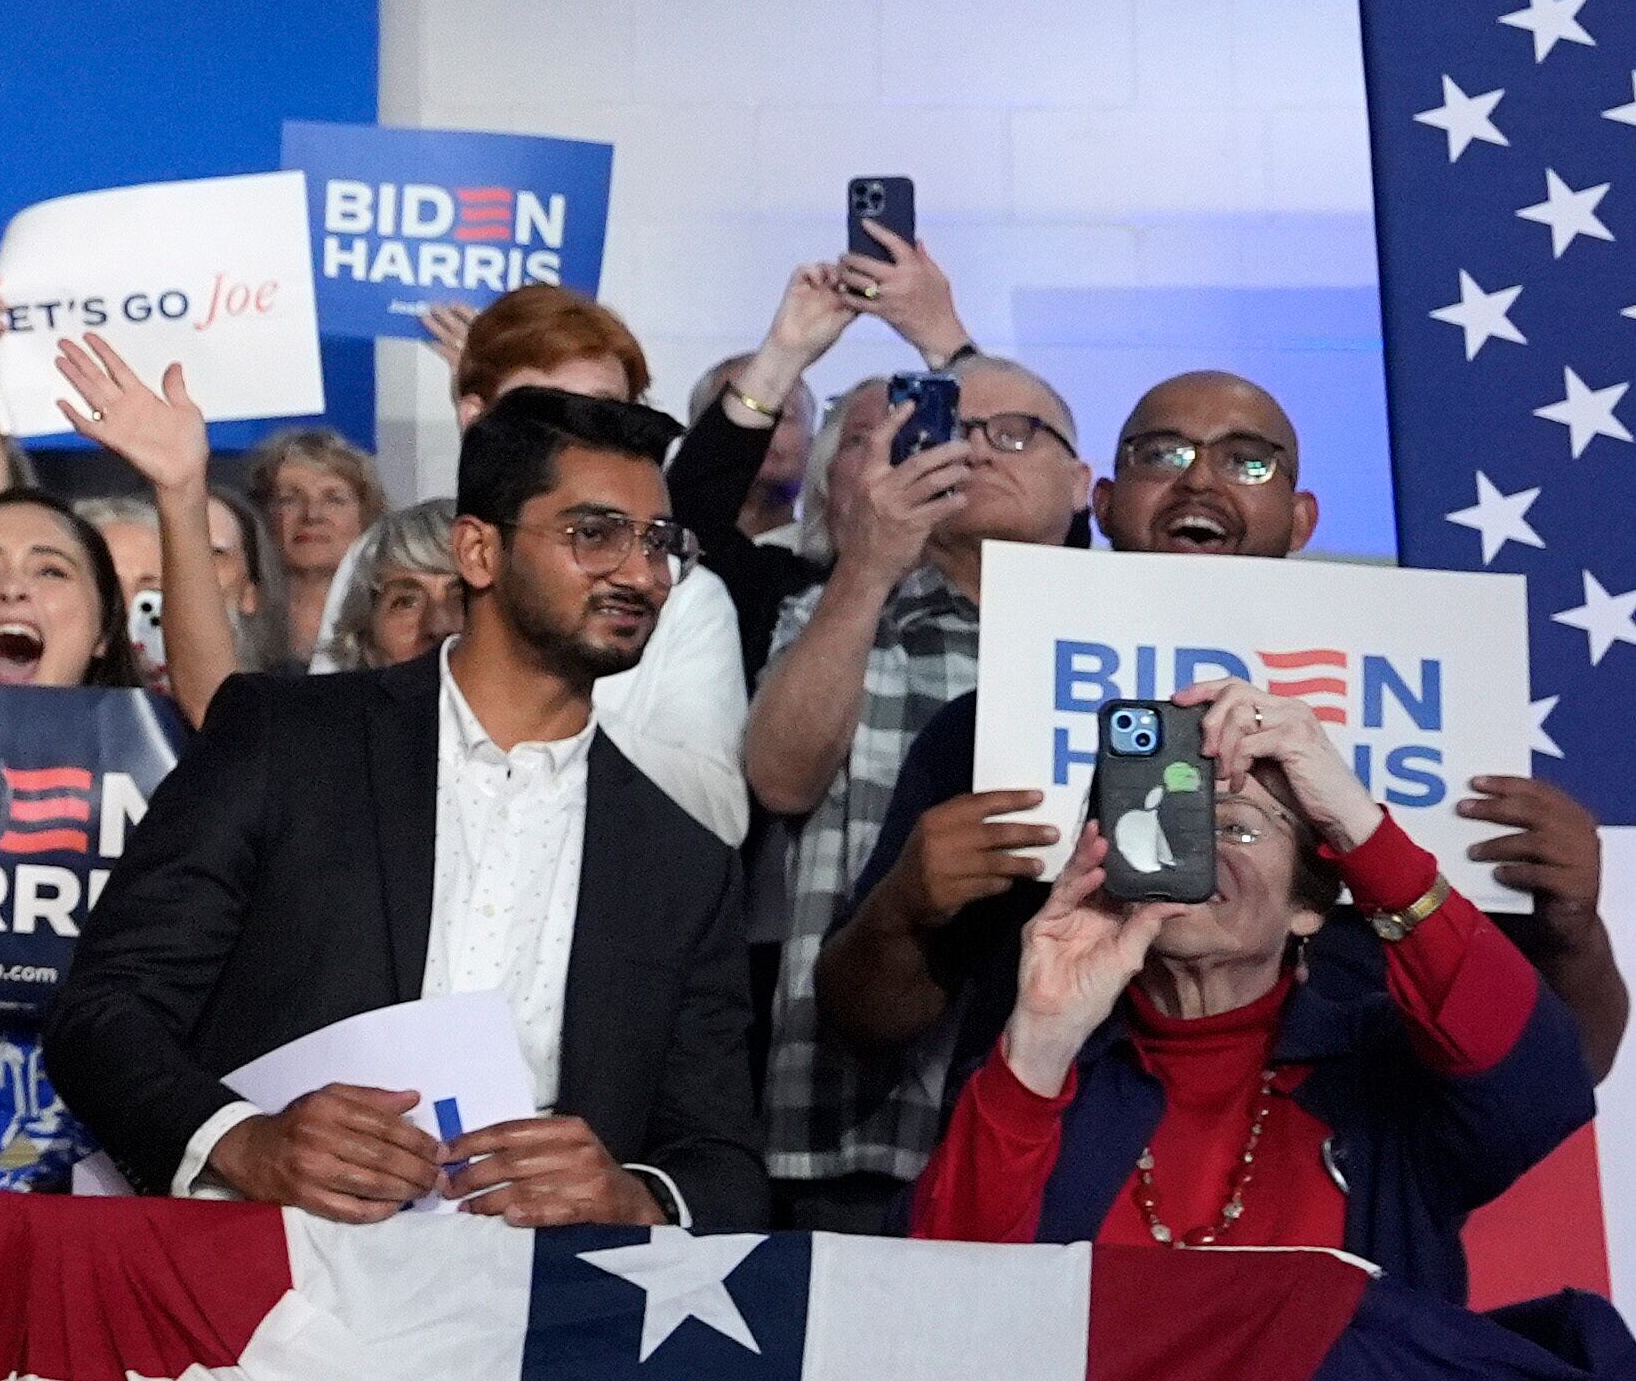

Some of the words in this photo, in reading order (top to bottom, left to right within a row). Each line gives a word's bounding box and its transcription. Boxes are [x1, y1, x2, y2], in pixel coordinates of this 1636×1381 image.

[324, 178, 567, 250] BIDEN
[323, 234, 562, 293] HARRIS
[7, 297, 108, 332] ET'S
[122, 290, 189, 322] GO
[194, 271, 280, 331] Joe
